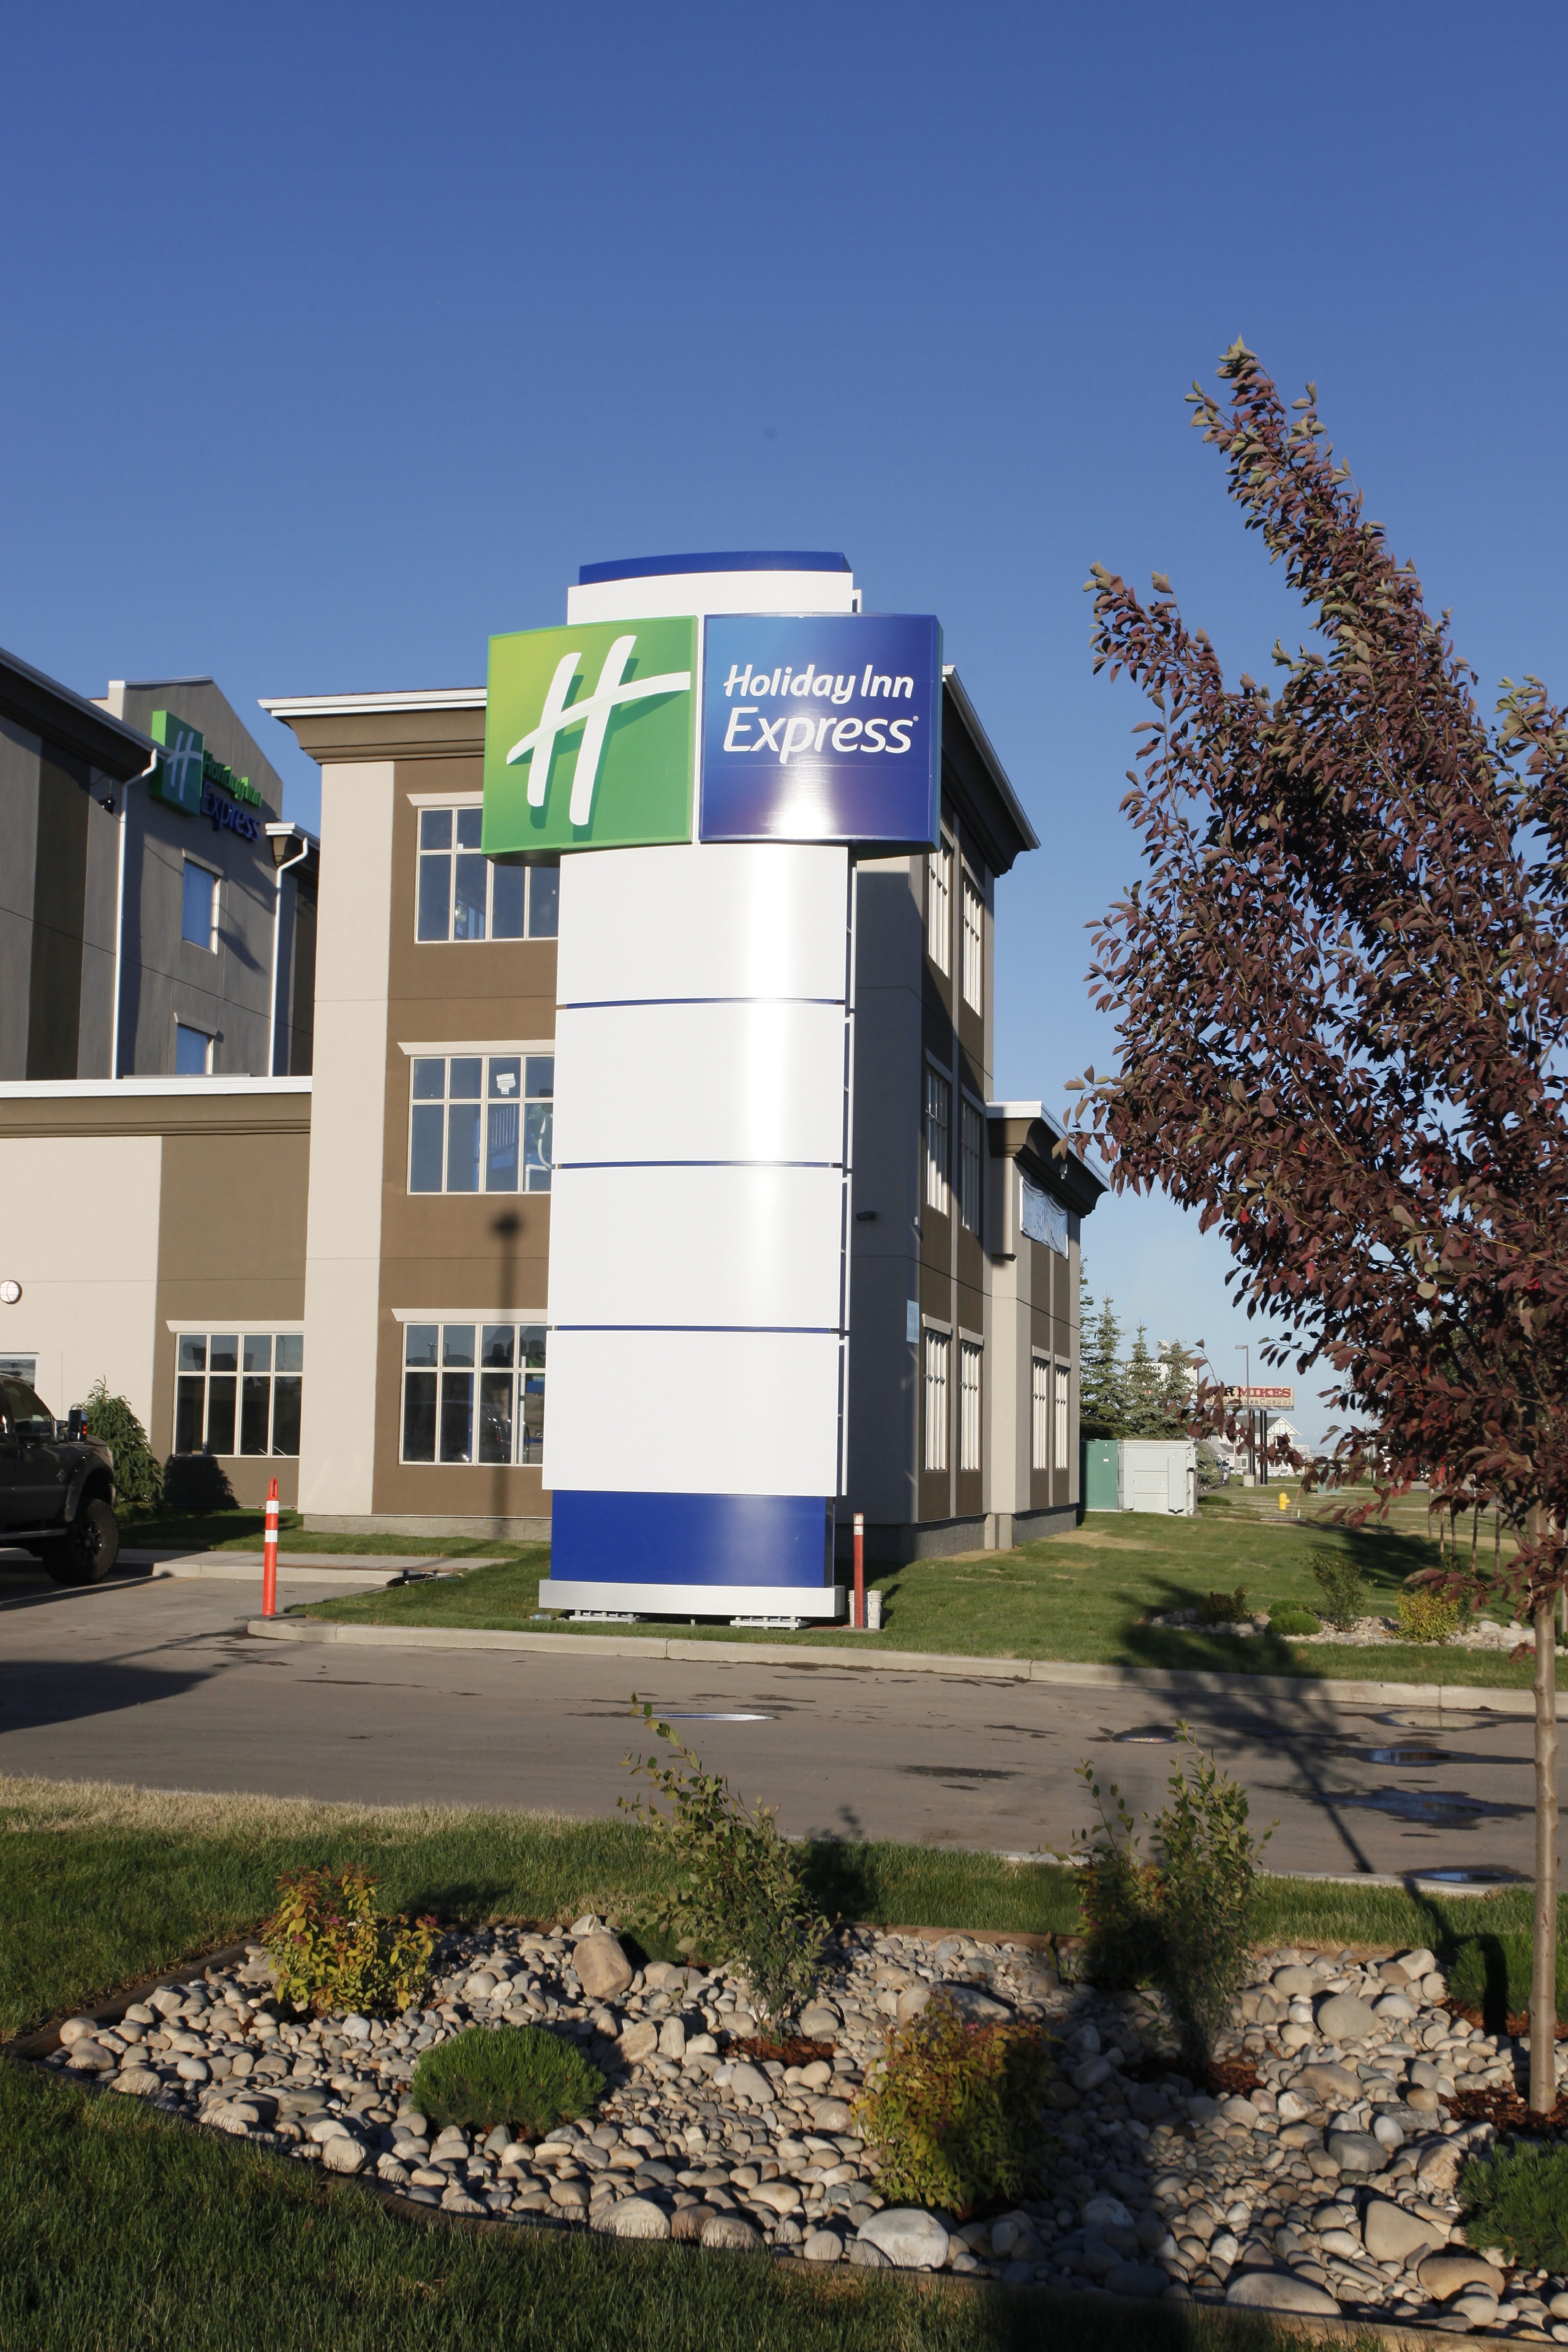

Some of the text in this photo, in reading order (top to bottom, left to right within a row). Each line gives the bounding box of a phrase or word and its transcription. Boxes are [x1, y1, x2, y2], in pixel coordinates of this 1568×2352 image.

[724, 664, 914, 704] Holiday Inn
[202, 779, 261, 842] Express
[1237, 1387, 1291, 1398] MIKES
